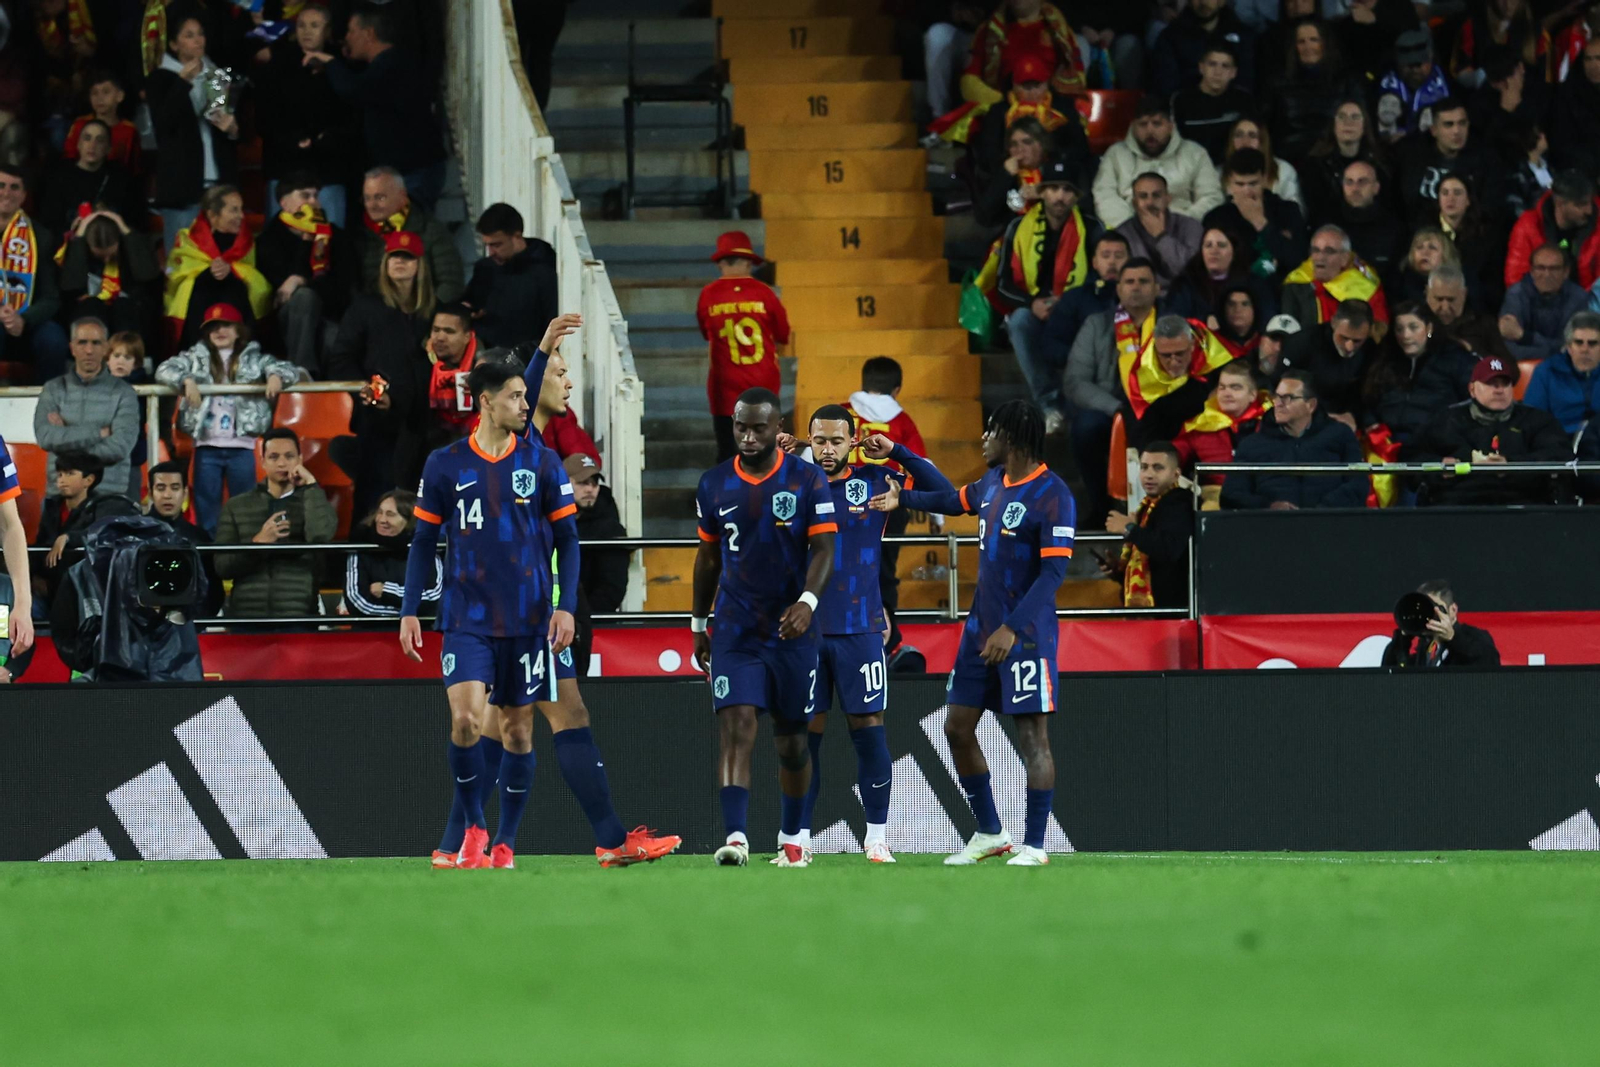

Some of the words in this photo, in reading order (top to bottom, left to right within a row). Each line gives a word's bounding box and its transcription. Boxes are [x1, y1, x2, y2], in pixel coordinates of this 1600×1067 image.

[789, 26, 808, 50] 17
[807, 95, 828, 118] 16
[824, 161, 844, 184] 15
[840, 226, 860, 250] 14
[857, 296, 876, 318] 13
[719, 316, 764, 365] 19
[457, 498, 484, 530] 14
[724, 522, 740, 552] 2
[518, 649, 546, 684] 14
[859, 660, 883, 692] 10
[1010, 660, 1038, 692] 12
